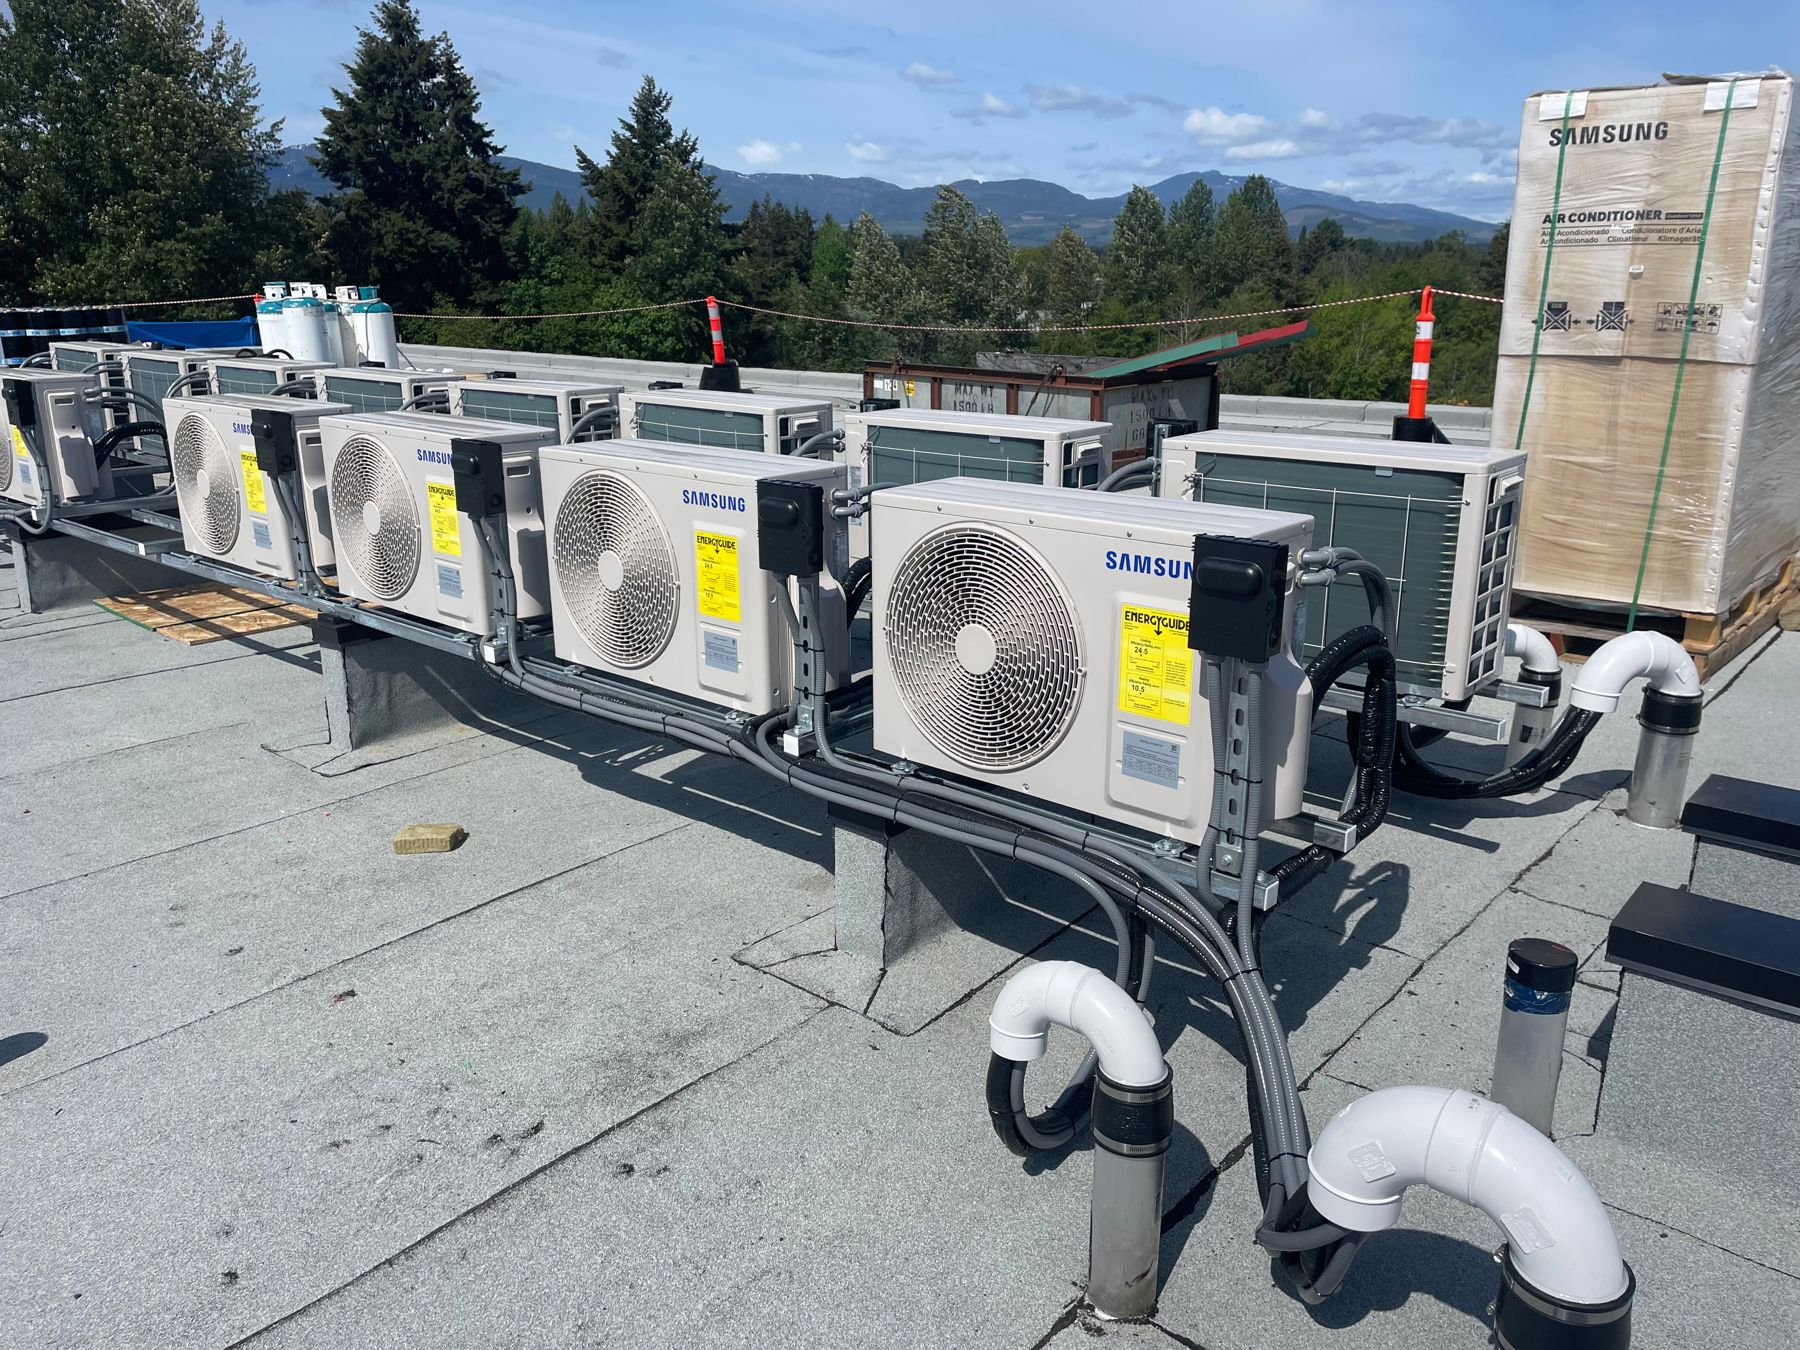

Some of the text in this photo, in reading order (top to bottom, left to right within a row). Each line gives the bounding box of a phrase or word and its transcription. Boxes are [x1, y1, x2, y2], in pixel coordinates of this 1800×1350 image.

[1549, 121, 1669, 147] SAMSUNG
[1542, 210, 1662, 224] AR CONDITIONER
[1557, 228, 1610, 236] Acondicionado
[1607, 235, 1649, 243] Climatiseur
[1551, 236, 1599, 244] ondicionado
[954, 383, 975, 397] MAX
[232, 422, 251, 435] SAMS
[417, 448, 453, 465] SAMSUN
[682, 489, 746, 513] SAMSUNG
[696, 535, 737, 550] ENERGYGUIDE
[1105, 550, 1194, 580] SAMSUN
[1124, 610, 1190, 632] ENERGYGUIDE
[1134, 646, 1148, 655] 24.5
[1131, 684, 1145, 693] 10.5
